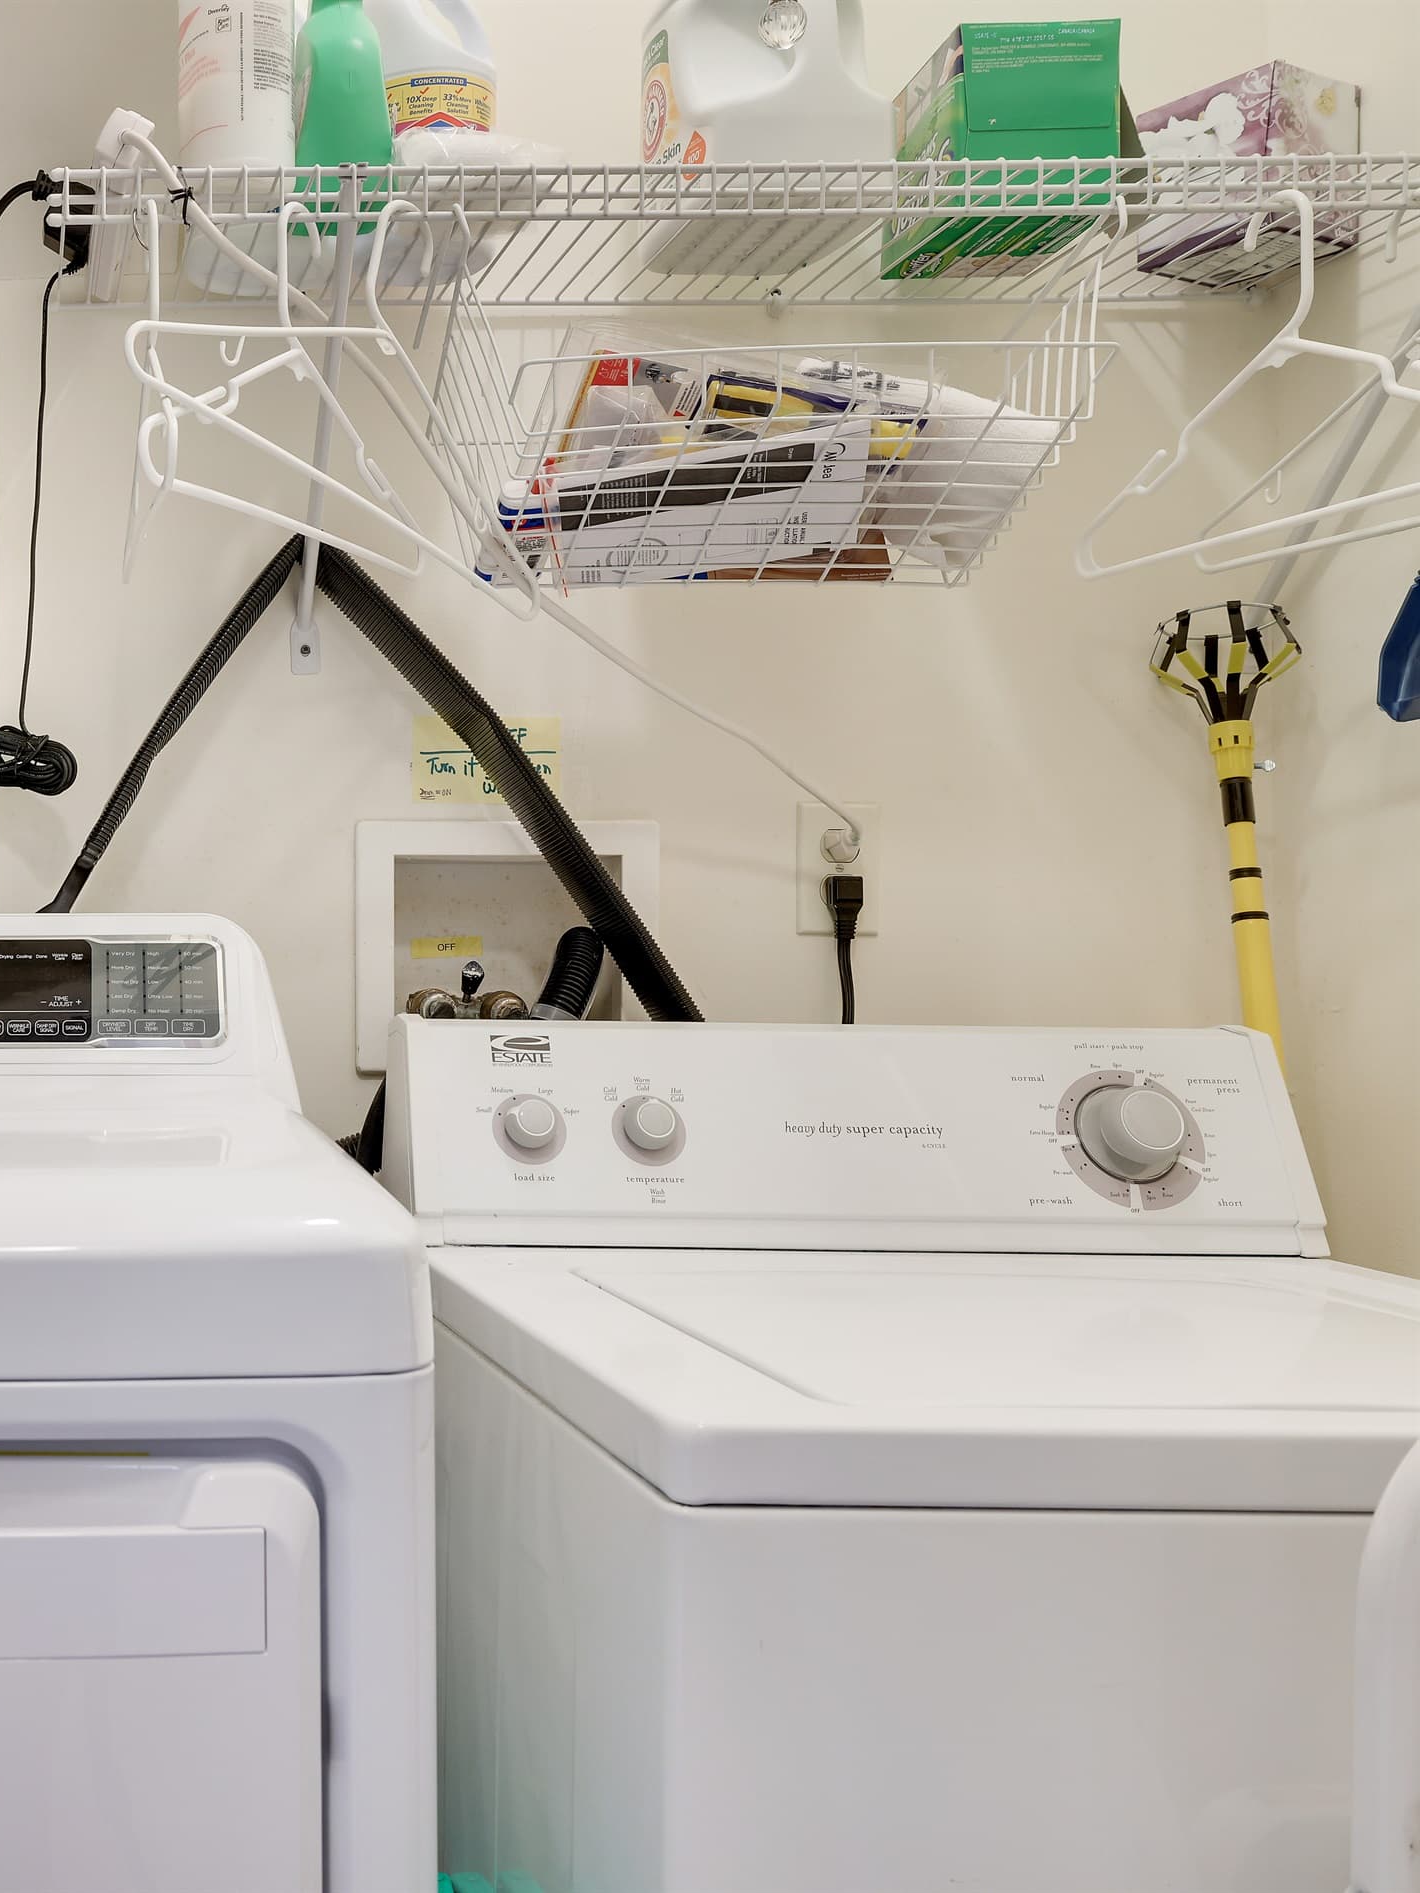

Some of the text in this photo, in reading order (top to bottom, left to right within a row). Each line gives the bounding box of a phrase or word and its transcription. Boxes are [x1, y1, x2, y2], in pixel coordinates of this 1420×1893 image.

[406, 96, 422, 104] 10X
[662, 142, 680, 164] Skin
[426, 756, 480, 777] Turn it
[437, 943, 456, 951] OFF
[492, 1052, 552, 1063] ESTATE
[1011, 1074, 1044, 1082] normal
[1188, 1078, 1238, 1086] permanent
[491, 1086, 513, 1094] Medium
[538, 1087, 554, 1095] Large
[1217, 1087, 1240, 1095] press
[564, 1107, 580, 1116] Super
[785, 1121, 943, 1139] heavy duty super capacity
[514, 1173, 555, 1182] load size
[626, 1176, 684, 1185] temperature
[1029, 1197, 1072, 1206] pre-wash
